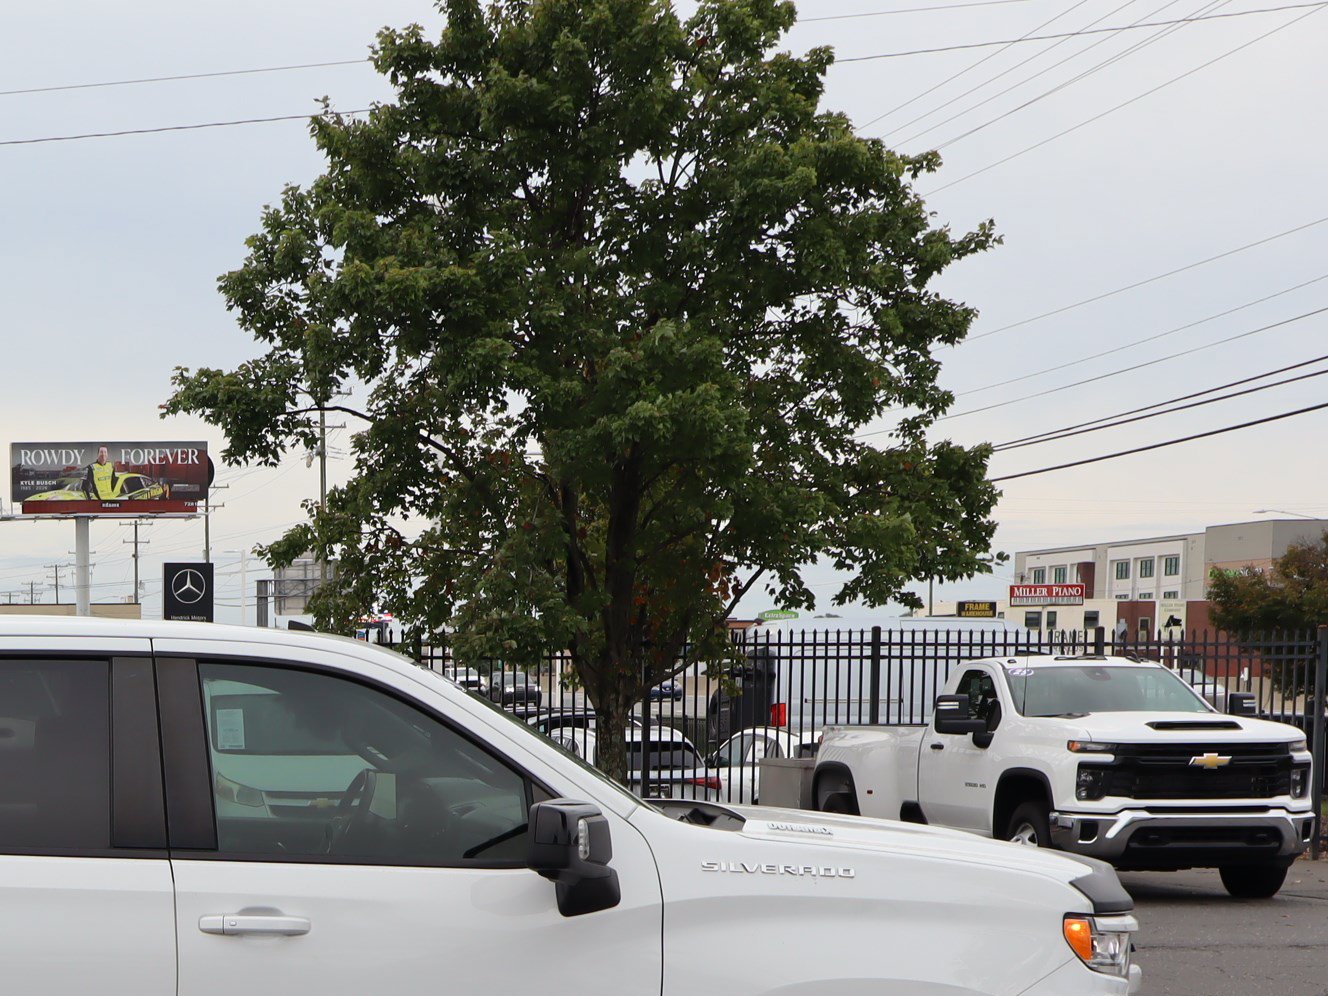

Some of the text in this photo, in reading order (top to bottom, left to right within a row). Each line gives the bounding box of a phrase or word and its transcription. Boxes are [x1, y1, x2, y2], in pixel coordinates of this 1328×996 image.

[21, 448, 199, 466] ROWDY FOREVER
[1013, 586, 1082, 597] MILLER PIANO
[700, 860, 855, 879] SILVERADO
